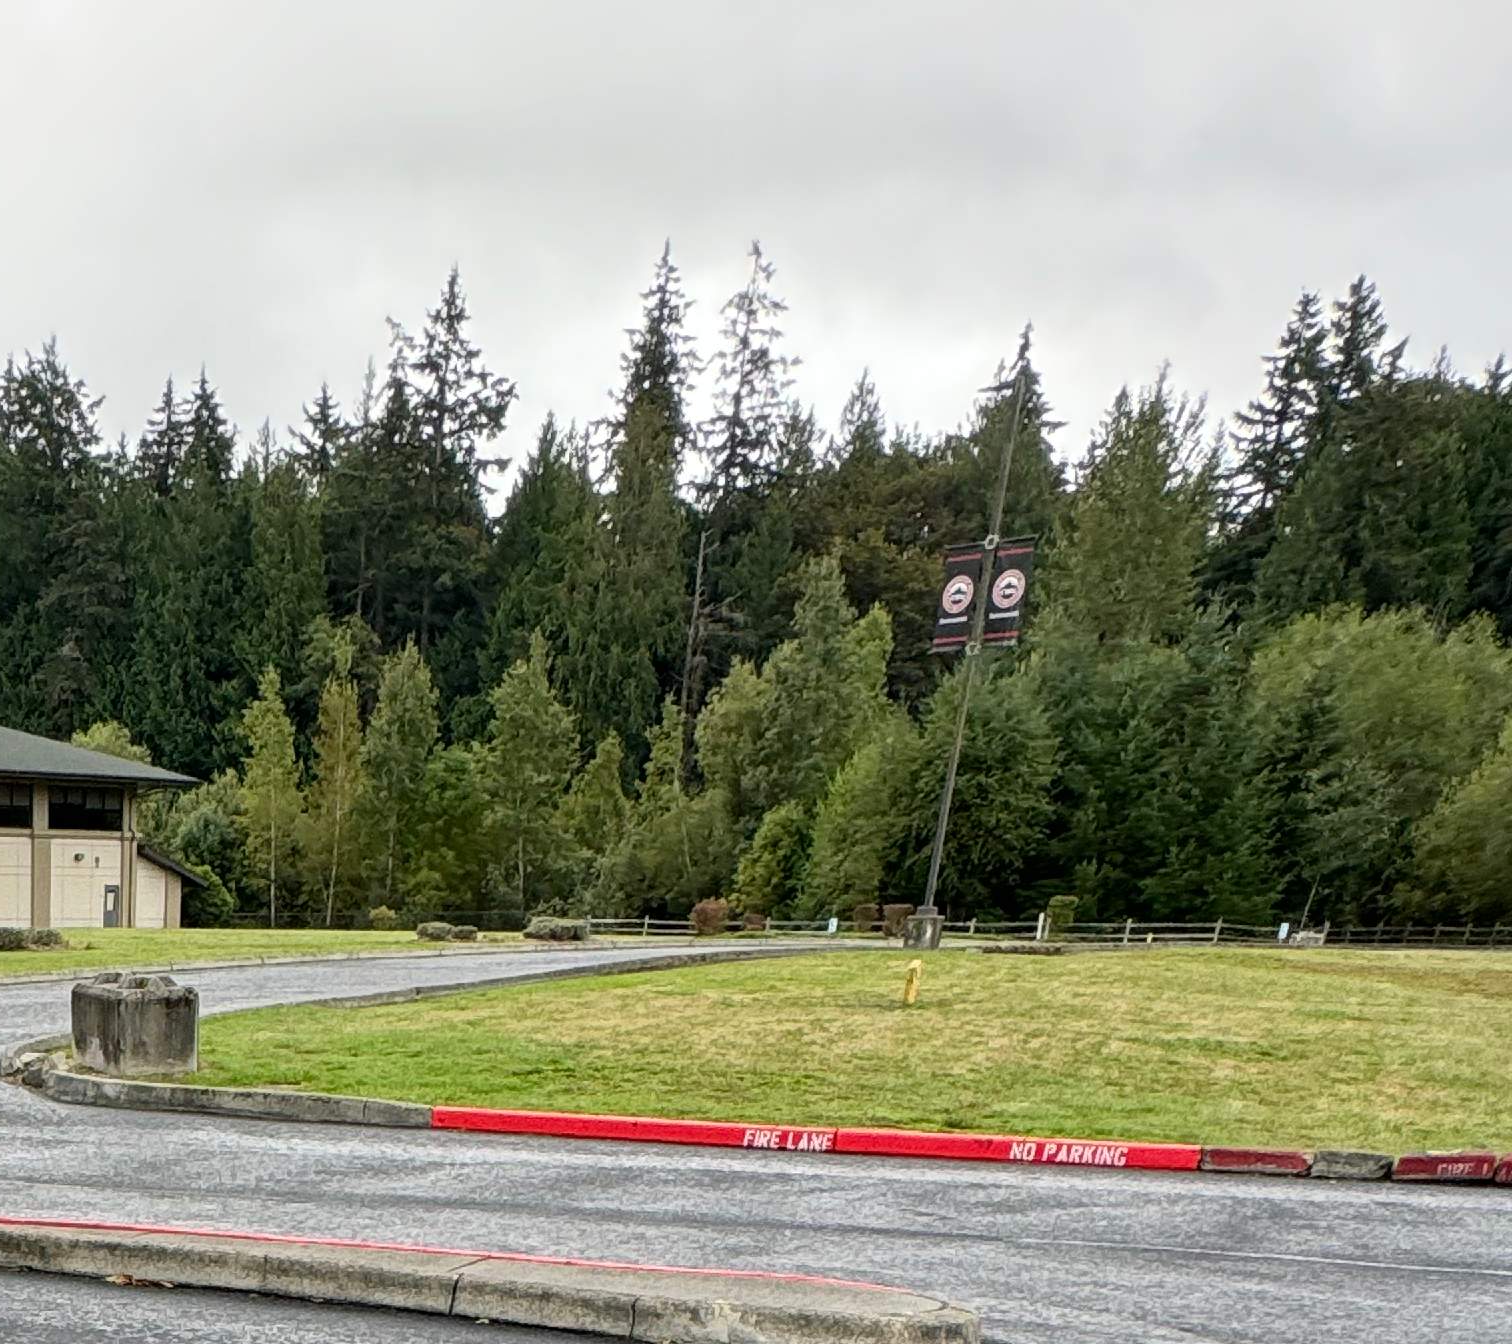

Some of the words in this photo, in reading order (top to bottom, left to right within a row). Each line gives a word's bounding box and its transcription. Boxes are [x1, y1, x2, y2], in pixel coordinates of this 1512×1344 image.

[743, 1129, 782, 1148] FIRE
[786, 1131, 834, 1151] LANE
[1009, 1142, 1036, 1161] NO
[1041, 1143, 1129, 1166] PARKING
